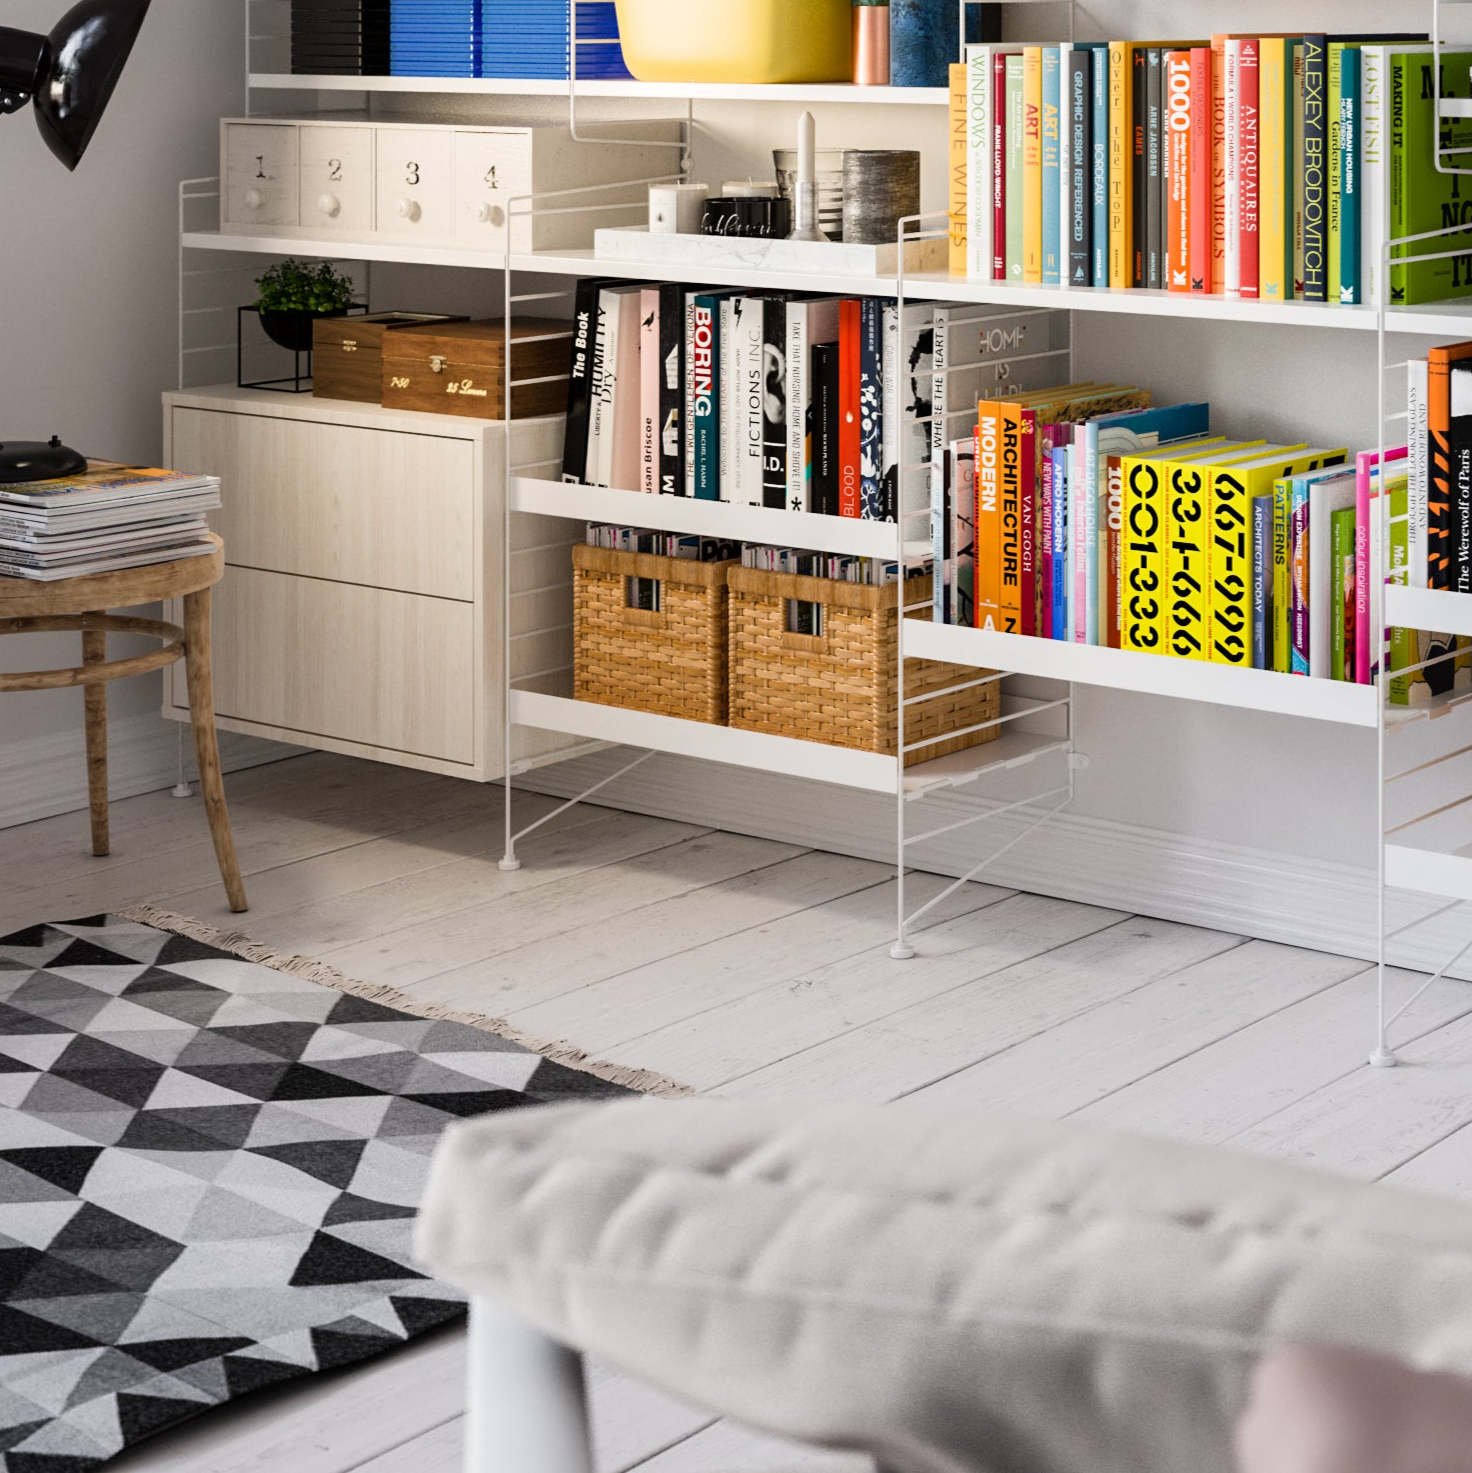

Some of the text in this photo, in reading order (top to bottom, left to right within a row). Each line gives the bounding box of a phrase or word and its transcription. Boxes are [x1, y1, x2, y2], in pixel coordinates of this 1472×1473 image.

[1026, 103, 1038, 140] ART
[1044, 103, 1058, 140] ART
[1170, 60, 1190, 131] 1000
[1365, 54, 1380, 163] LOST FISH
[1393, 66, 1403, 148] MAKING IT
[256, 156, 266, 178] 1
[328, 159, 342, 181] 2
[406, 161, 420, 185] 3
[483, 166, 498, 189] 4
[953, 93, 966, 248] FINE WINES
[1074, 71, 1083, 242] GRAPHIC DESIGN REFERENCED
[1094, 144, 1103, 205] BORDEAUX
[1135, 126, 1143, 155] EAMES
[1245, 105, 1256, 232] ANTIQUAIRES
[1304, 41, 1322, 285] ALEXEY BRODOVITCH
[573, 311, 589, 378] The Book
[695, 307, 712, 417] BORING
[749, 325, 760, 457] FICTIONS INC.
[844, 465, 855, 517] BLOOD
[981, 416, 996, 512] MODERN
[1003, 417, 1018, 586] ARCHITECTURE
[1108, 466, 1122, 531] 1000
[1023, 494, 1032, 572] VAN GOGH
[1254, 506, 1263, 613] ARCHITECTS TODAY
[1275, 484, 1285, 565] PATTERNS
[1458, 449, 1470, 593] The Werewolf of Paris
[1358, 525, 1367, 613] colour inspiration
